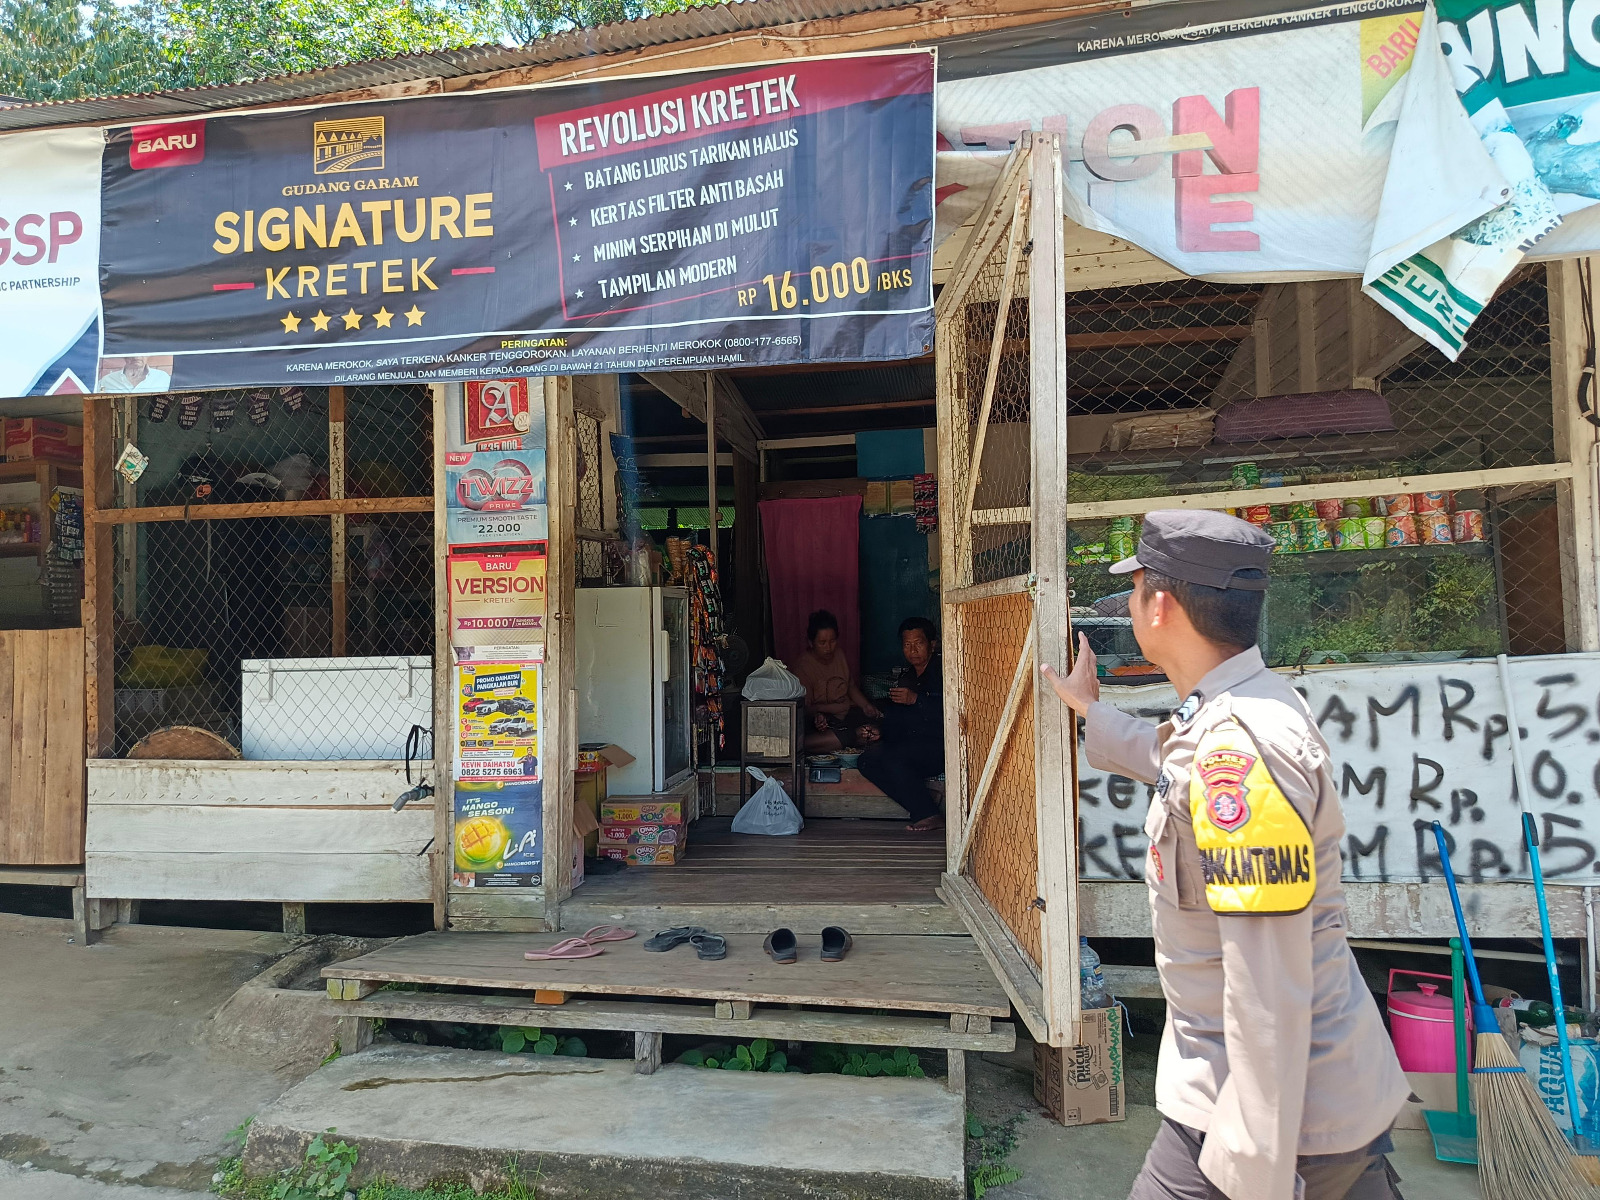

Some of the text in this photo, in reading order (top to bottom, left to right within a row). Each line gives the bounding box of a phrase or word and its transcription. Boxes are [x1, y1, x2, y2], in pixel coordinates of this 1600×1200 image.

[1077, 36, 1124, 53] KARENA
[559, 74, 800, 156] REVOLUSI KRETEK
[137, 133, 197, 154] BARU
[584, 128, 799, 190] BATANG LURUS TARIKAN HALUS
[282, 175, 419, 197] GUDANG GARAM
[590, 170, 784, 228] KERTAS FILTER ANTI BASAH
[213, 192, 495, 254] SIGNATURE
[593, 208, 780, 263] MINIM SERPIHAN DI MULUT
[9, 276, 81, 291] PARTNERSHIP
[265, 257, 440, 300] KRETEK
[598, 255, 737, 300] TAMPILAN MODERN
[738, 288, 757, 308] RP
[762, 257, 870, 311] 16.000
[286, 363, 323, 372] KARENA
[376, 358, 399, 367] SAYA
[401, 355, 444, 365] TERKENA
[447, 352, 487, 363] KANKER
[489, 349, 569, 361] TENGGOROKAN.
[572, 347, 616, 357] LAYANAN
[619, 343, 668, 354] BERHENTI
[671, 339, 722, 350] MEROKOK
[724, 335, 802, 349] (0800-177-6565)
[501, 338, 568, 349] PERINGATAN:
[334, 353, 745, 382] DILARANG MENJUAL DAN MEMBERI KEPADA ORANG DI BAWAH 21 TAHUN DAN PEREMPUAN HAMIL
[460, 477, 534, 497] TWIZZ
[486, 562, 512, 571] BARU
[455, 576, 544, 595] VERSION
[477, 682, 507, 690] PANGKALAN
[462, 801, 498, 812] MANGO
[468, 807, 515, 817] SEASON!
